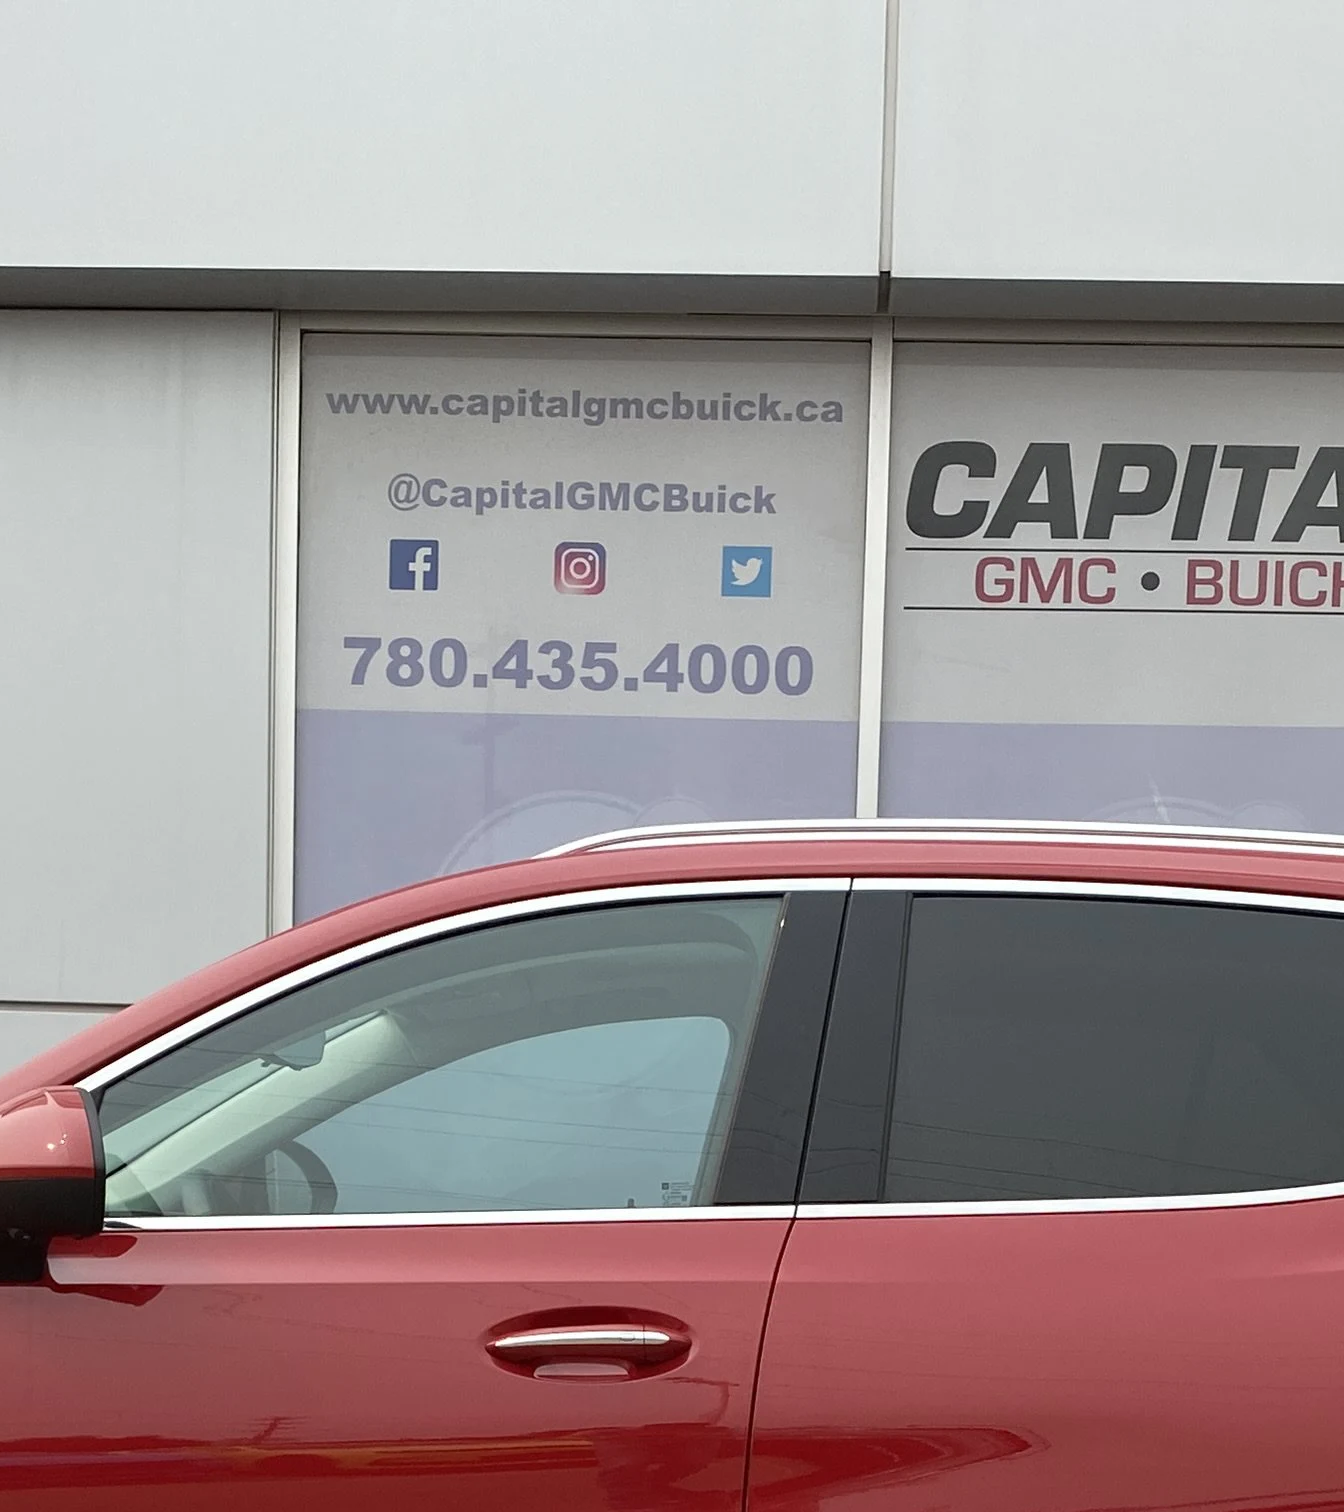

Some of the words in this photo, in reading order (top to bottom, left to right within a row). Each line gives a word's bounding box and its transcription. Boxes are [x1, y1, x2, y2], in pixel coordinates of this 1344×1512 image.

[325, 388, 844, 427] www.capitalgmcbuick.ca
[387, 472, 777, 516] @CapitalGMCBuick
[974, 556, 1117, 605] GMC
[343, 635, 814, 696] 780.435.4000
